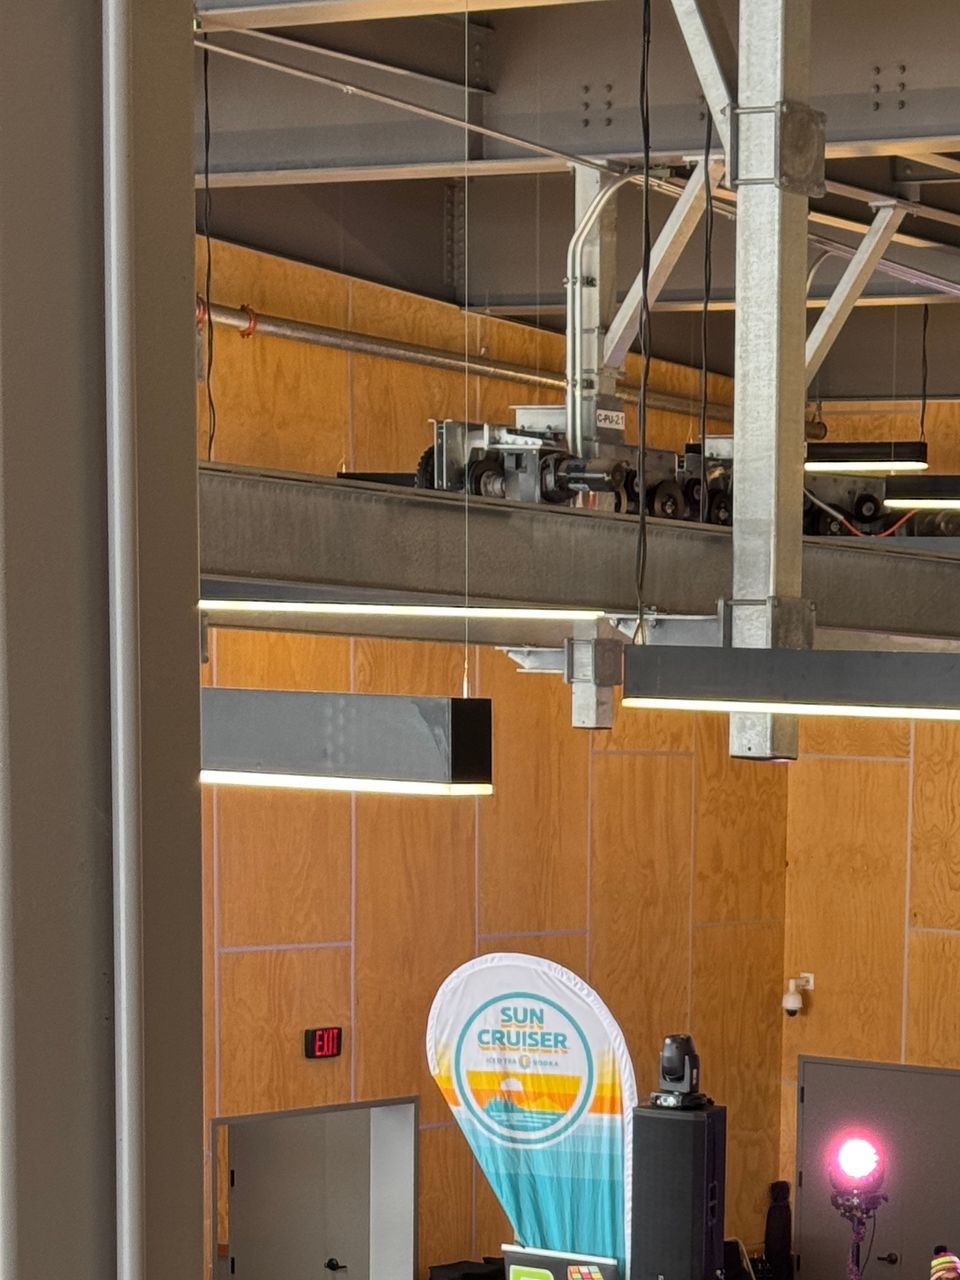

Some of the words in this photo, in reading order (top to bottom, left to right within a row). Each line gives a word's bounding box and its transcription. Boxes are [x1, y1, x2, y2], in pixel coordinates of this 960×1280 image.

[500, 1006, 544, 1027] SUN
[315, 1028, 339, 1056] EXIT
[477, 1029, 568, 1051] CRUISER
